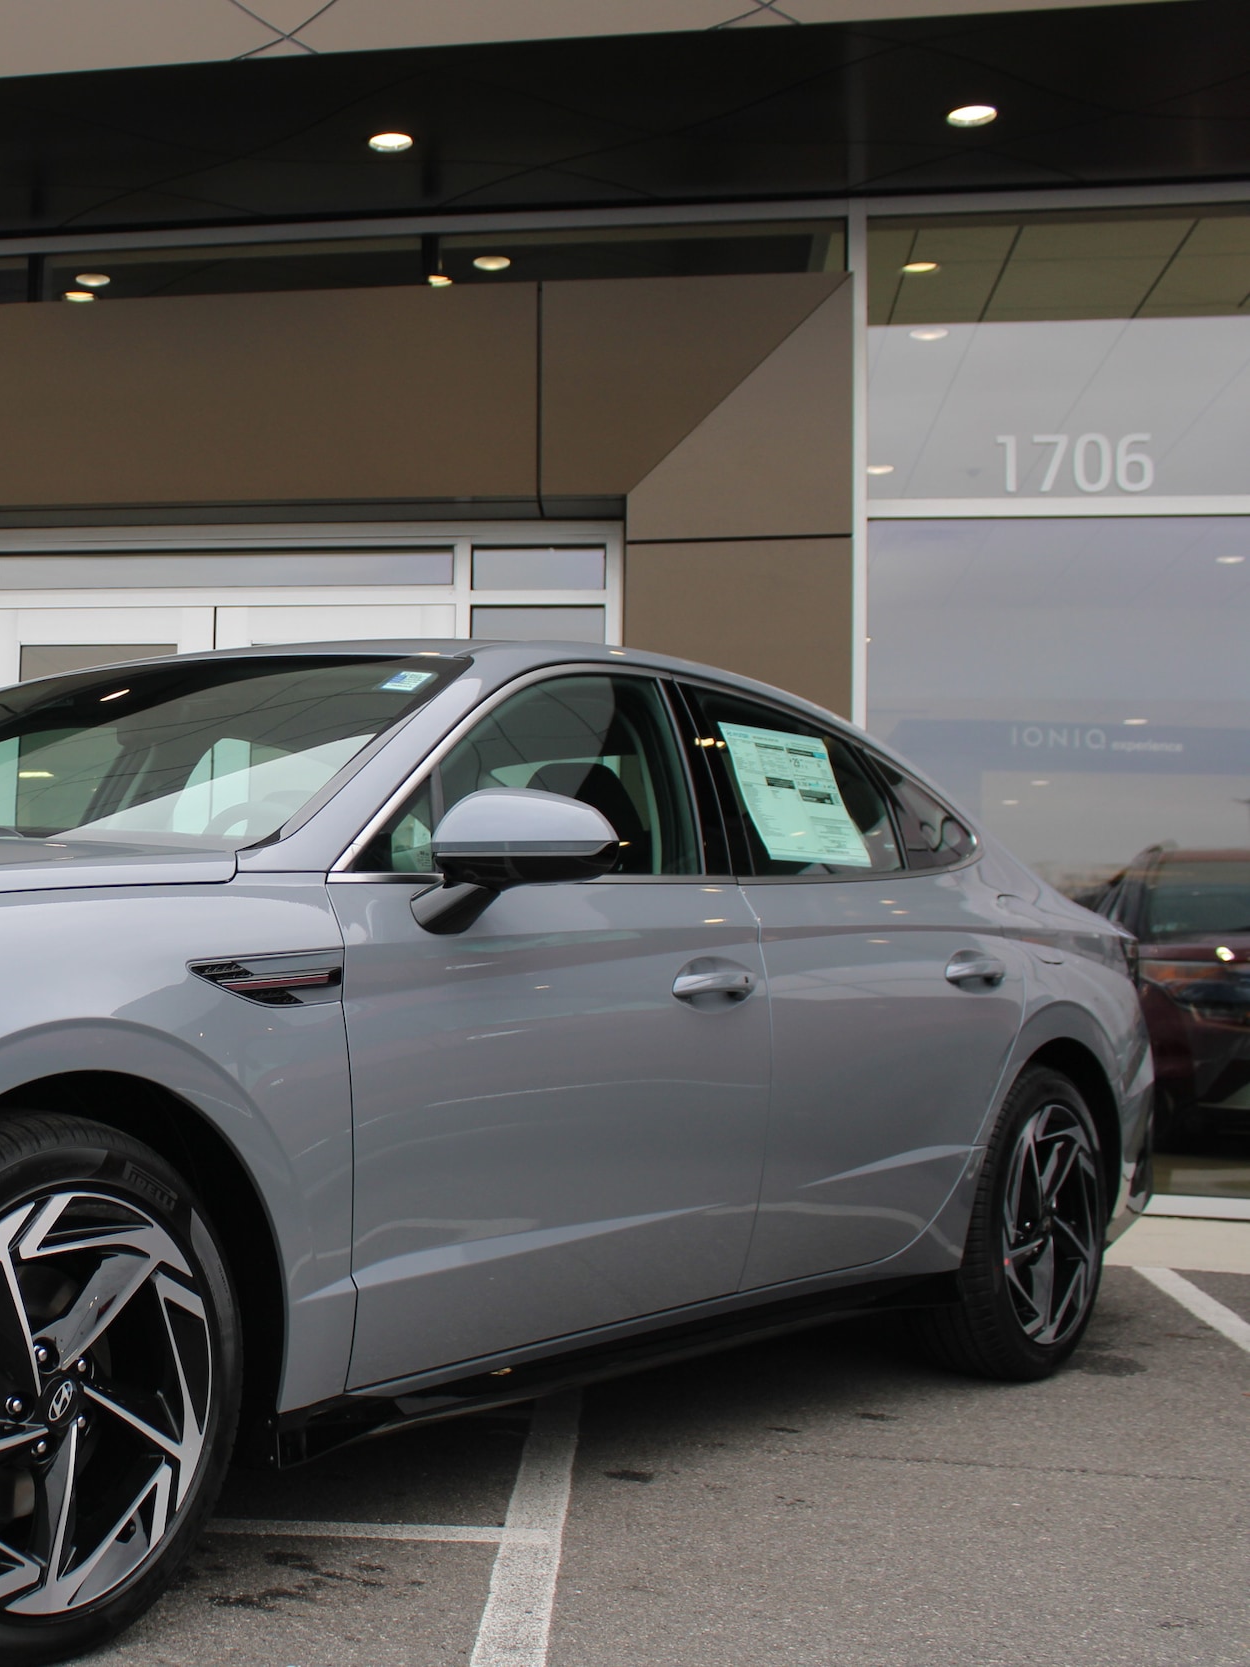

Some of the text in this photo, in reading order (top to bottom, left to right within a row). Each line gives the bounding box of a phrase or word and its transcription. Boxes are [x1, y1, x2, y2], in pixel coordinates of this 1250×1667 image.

[995, 432, 1155, 493] 1706
[1010, 725, 1184, 753] IONIQ experience
[121, 1160, 179, 1211] PIRELLI
